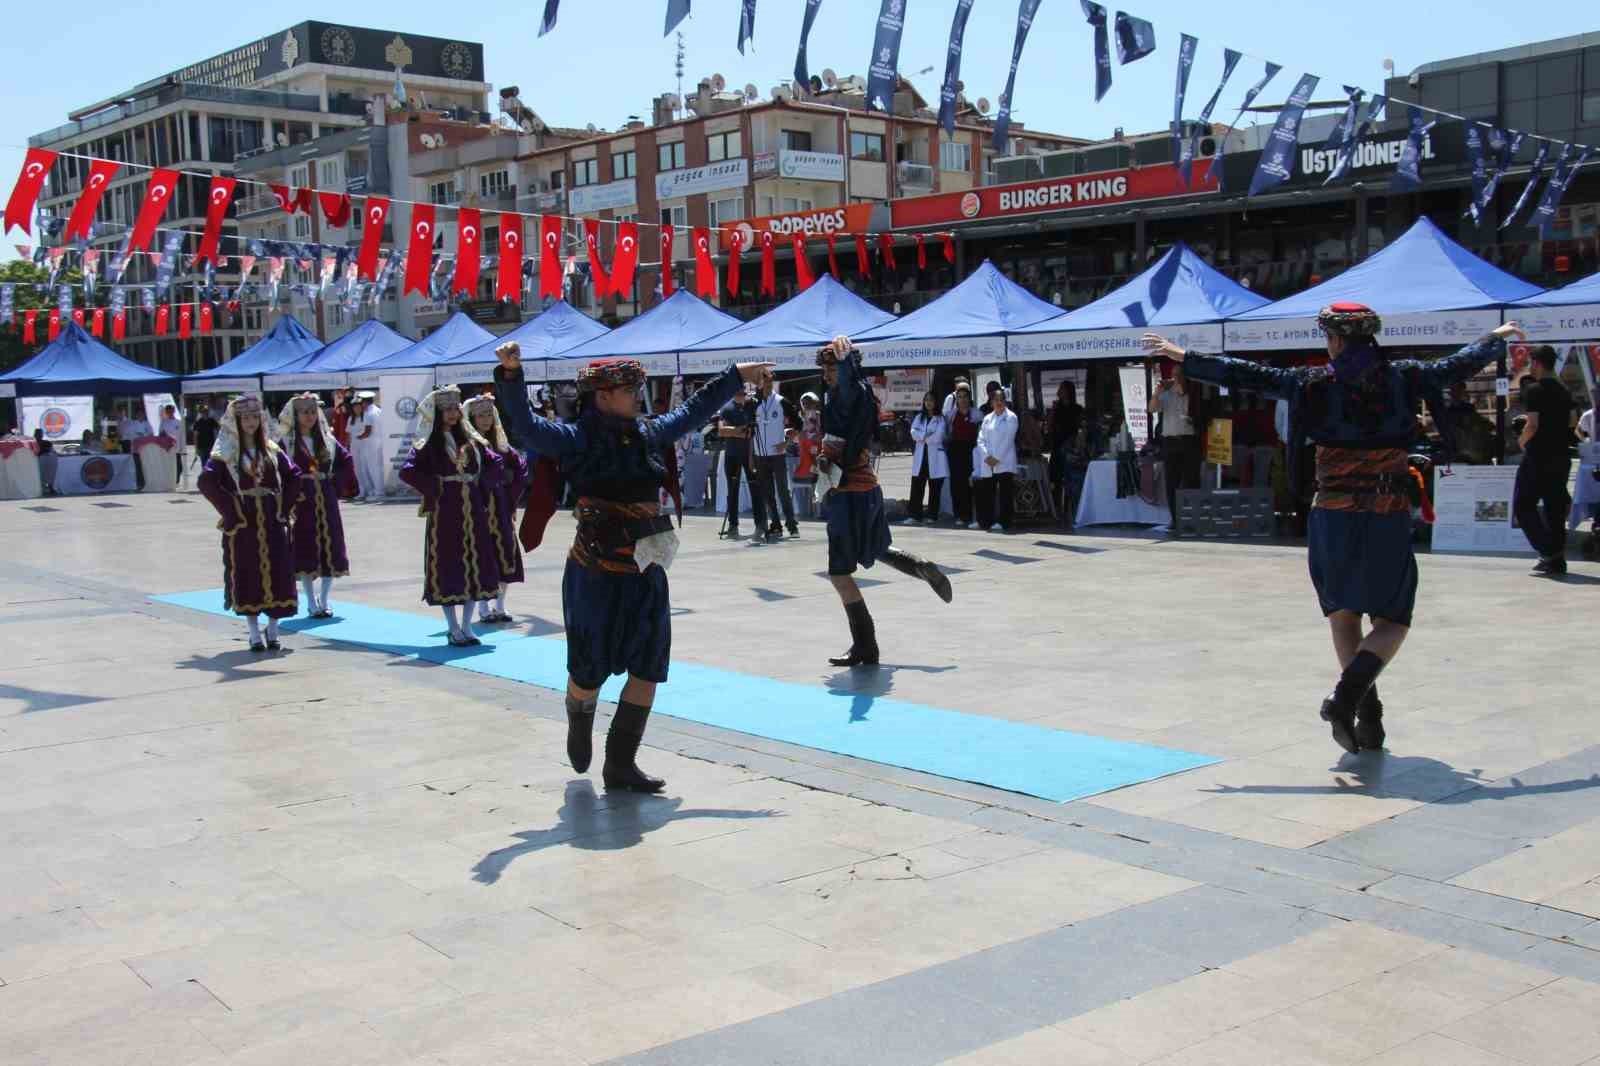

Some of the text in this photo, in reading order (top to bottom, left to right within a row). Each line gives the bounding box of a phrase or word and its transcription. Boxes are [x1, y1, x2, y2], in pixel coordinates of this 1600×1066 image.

[1302, 149, 1351, 174] UST
[1000, 184, 1073, 210] BURGER
[1077, 176, 1127, 201] KING
[1560, 318, 1579, 329] T.C.
[1076, 337, 1131, 351] BÜYÜKŞEHİR
[886, 347, 930, 359] BÜYÜKŞEHİR
